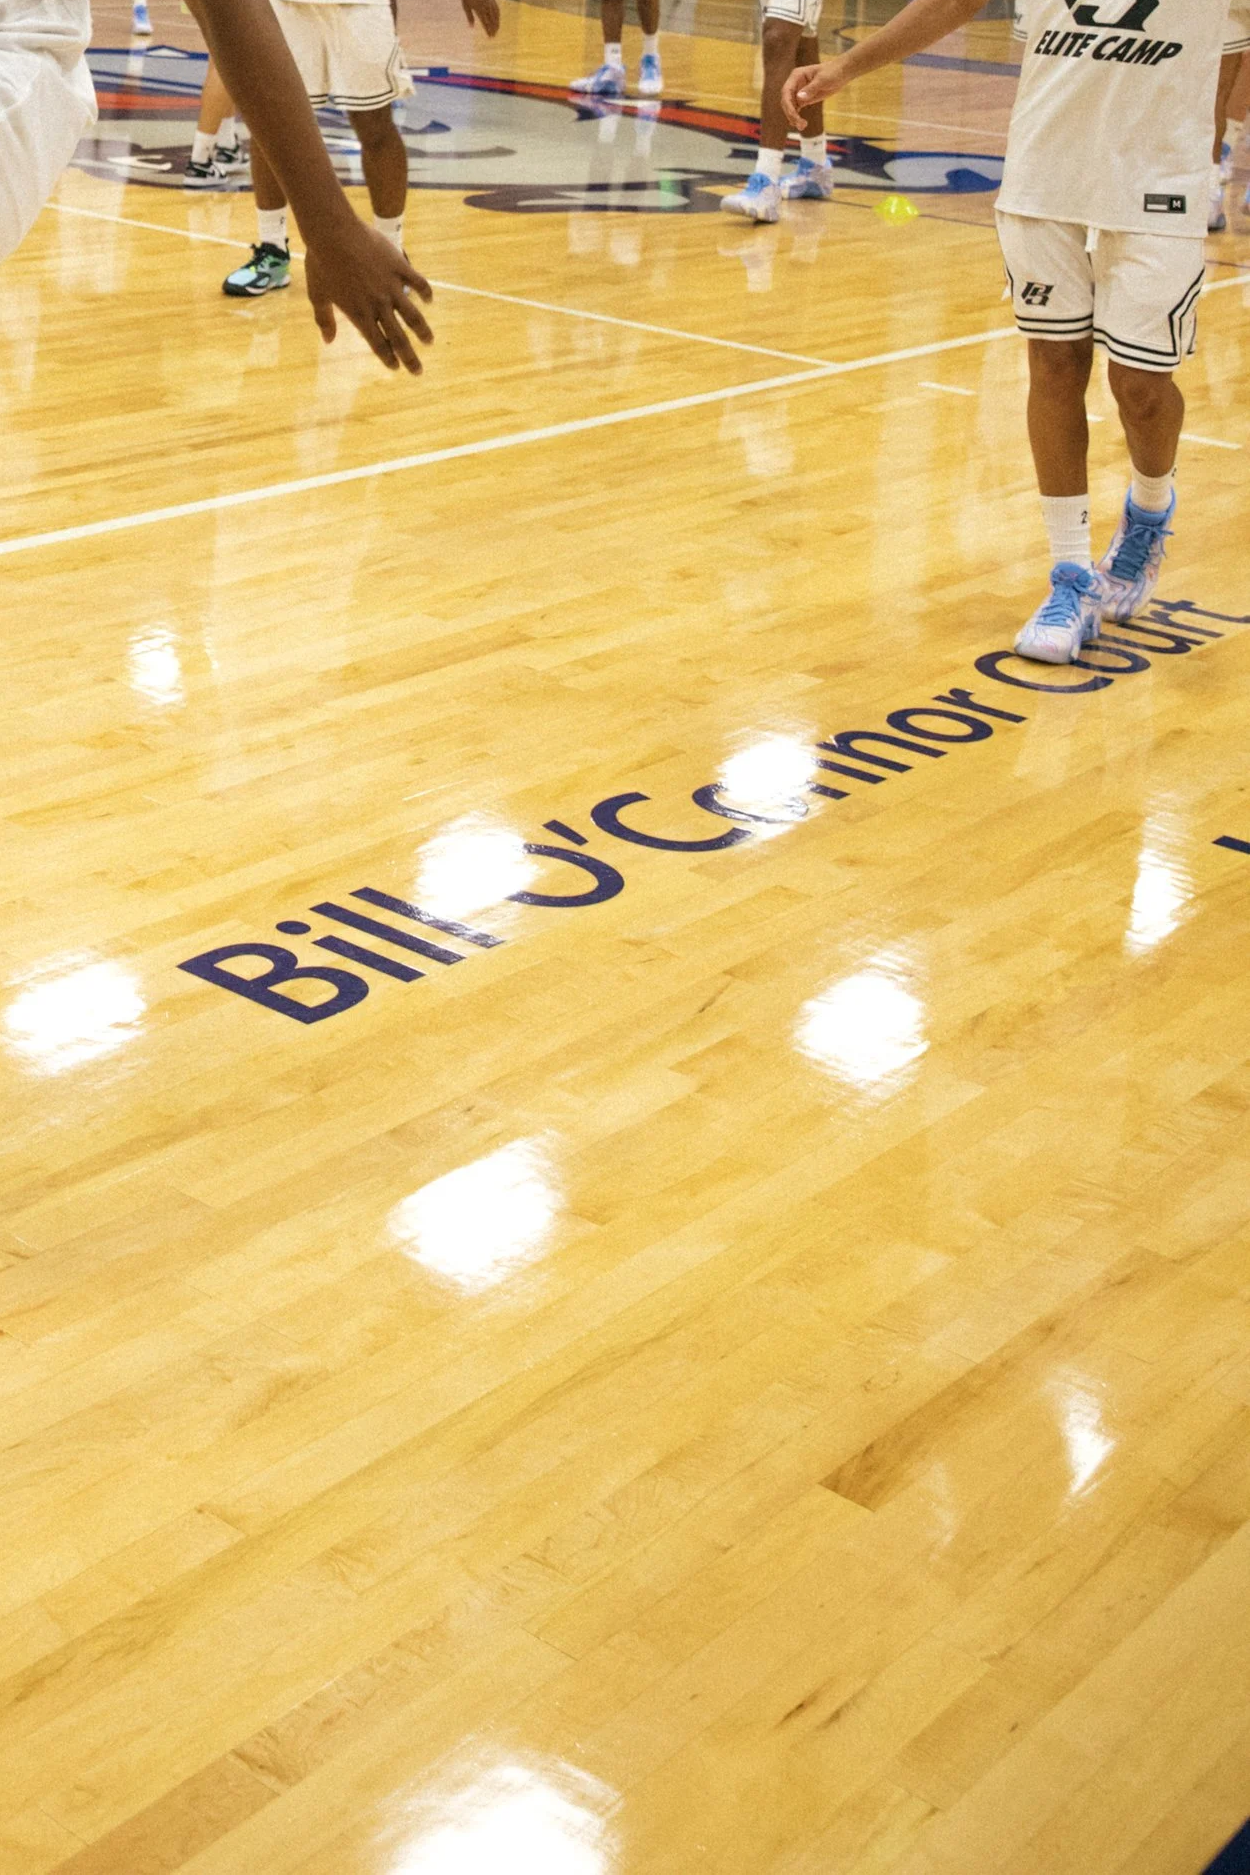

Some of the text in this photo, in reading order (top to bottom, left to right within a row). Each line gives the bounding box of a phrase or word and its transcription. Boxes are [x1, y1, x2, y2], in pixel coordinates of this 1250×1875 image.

[1034, 30, 1183, 66] ELITE CAMP
[176, 886, 504, 1025] Bill
[974, 598, 1250, 693] Court
